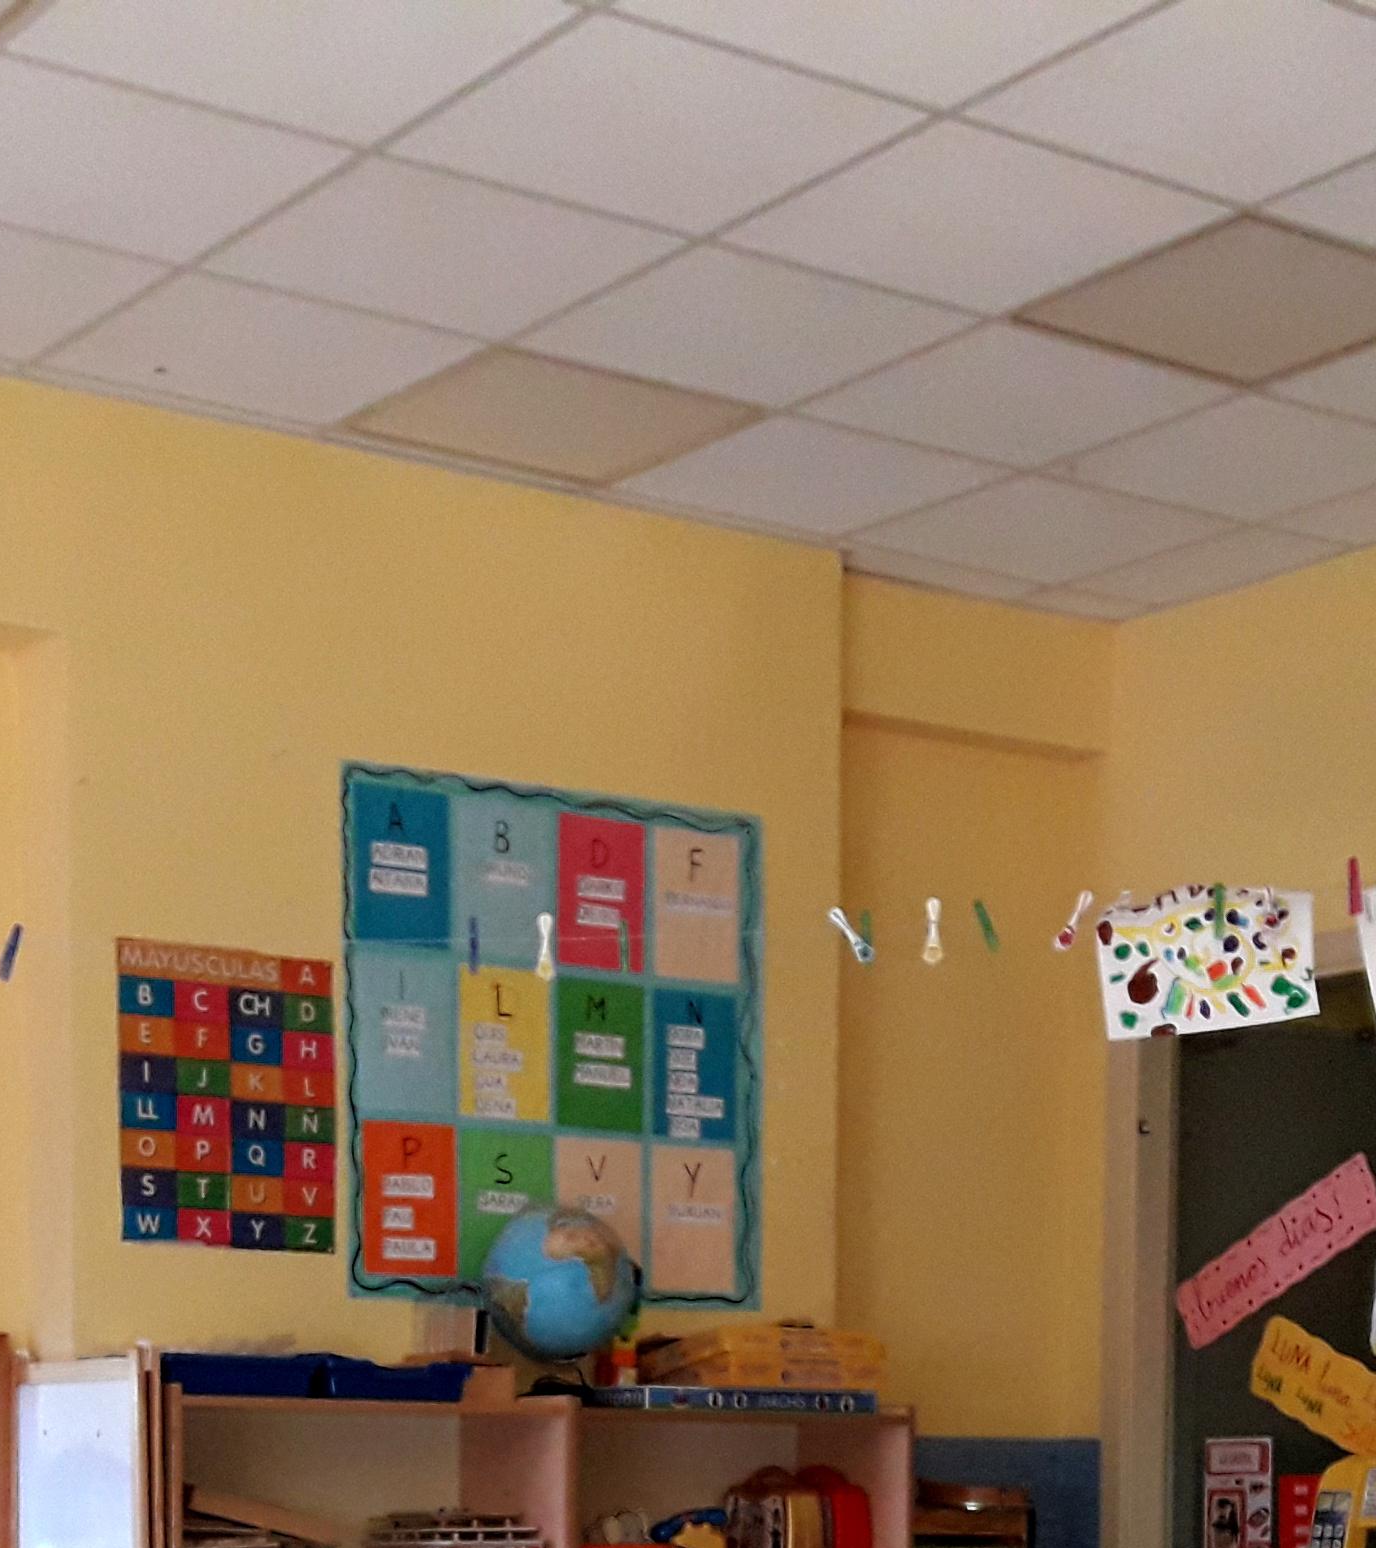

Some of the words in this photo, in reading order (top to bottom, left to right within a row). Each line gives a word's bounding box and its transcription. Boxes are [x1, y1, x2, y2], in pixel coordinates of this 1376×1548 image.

[389, 801, 404, 831] A
[494, 819, 511, 854] B
[591, 838, 610, 869] D
[689, 848, 704, 883] F
[299, 964, 315, 985] A
[137, 984, 153, 1006] B
[193, 991, 208, 1012] C
[238, 993, 270, 1017] CH
[301, 1002, 316, 1022] D
[493, 983, 513, 1017] L
[585, 994, 606, 1021] M
[140, 1023, 151, 1043] E
[197, 1028, 208, 1048] F
[247, 1033, 264, 1055] G
[300, 1040, 317, 1060] H
[143, 1060, 150, 1083] I
[197, 1068, 207, 1088] J
[250, 1073, 264, 1092] K
[304, 1077, 315, 1097] L
[192, 1104, 214, 1126] M
[249, 1108, 266, 1130] N
[139, 1136, 156, 1157] O
[196, 1140, 211, 1161] P
[248, 1145, 266, 1168] Q
[302, 1148, 316, 1169] R
[402, 1136, 422, 1169] P
[494, 1152, 514, 1185] S
[586, 1155, 607, 1182] V
[141, 1175, 156, 1197] S
[196, 1178, 210, 1199] T
[249, 1183, 265, 1204] U
[302, 1187, 318, 1206] V
[683, 1162, 703, 1199] Y
[137, 1213, 160, 1234] W
[196, 1217, 212, 1238] X
[250, 1219, 265, 1240] Y
[302, 1223, 318, 1244] Z
